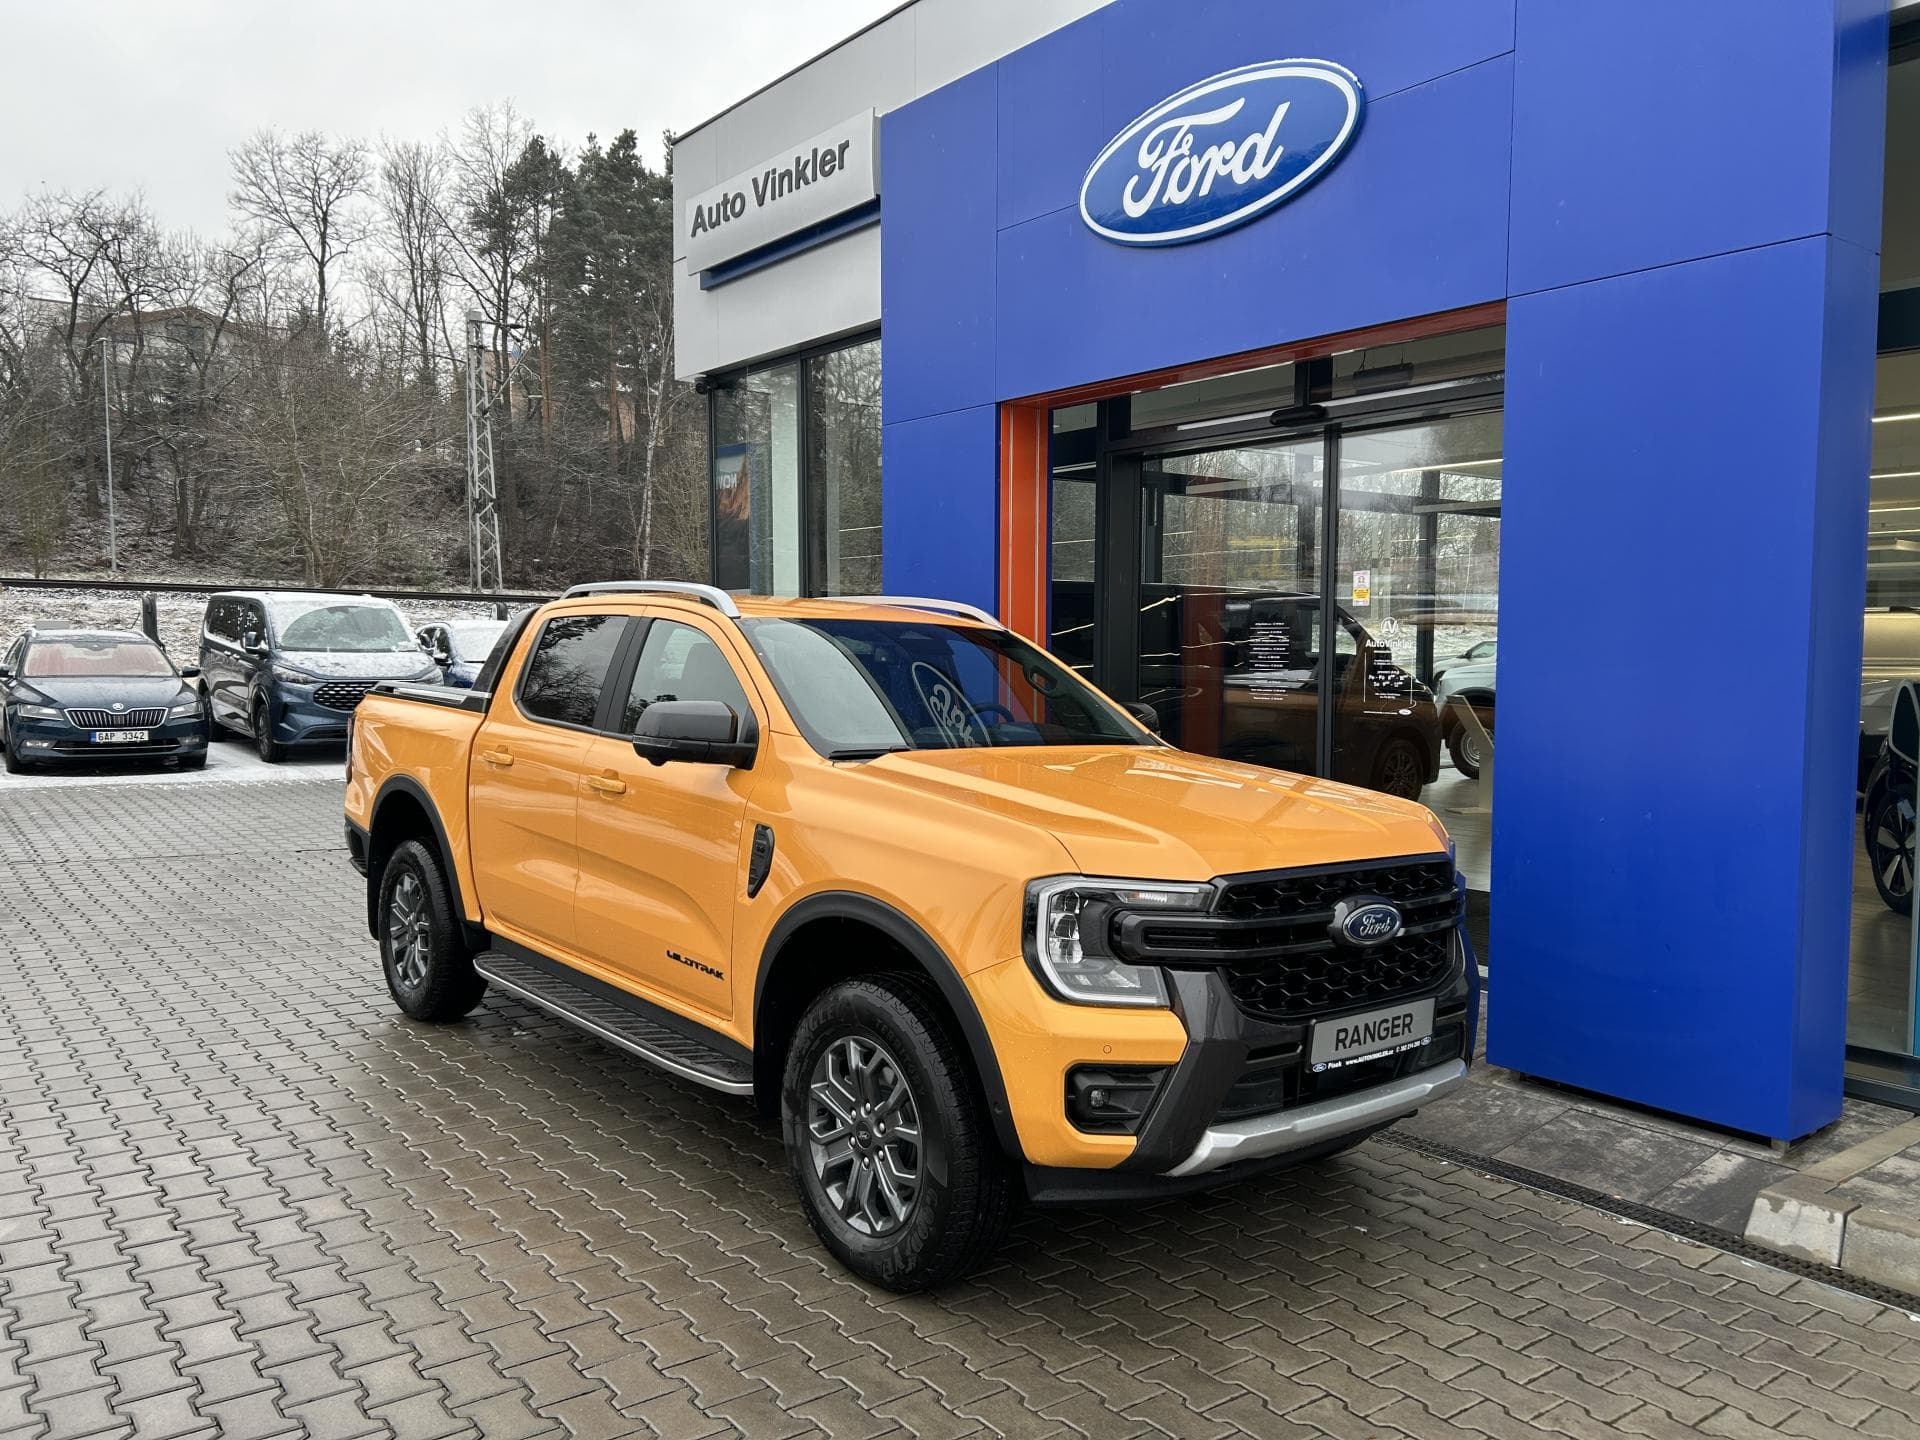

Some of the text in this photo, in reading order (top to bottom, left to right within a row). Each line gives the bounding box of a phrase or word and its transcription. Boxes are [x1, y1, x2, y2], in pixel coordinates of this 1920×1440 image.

[1123, 97, 1290, 218] Ford
[691, 140, 850, 238] Auto Vinkler
[98, 731, 145, 741] 6AP 3342
[1360, 913, 1391, 936] Ford
[1335, 1013, 1413, 1051] RANGER
